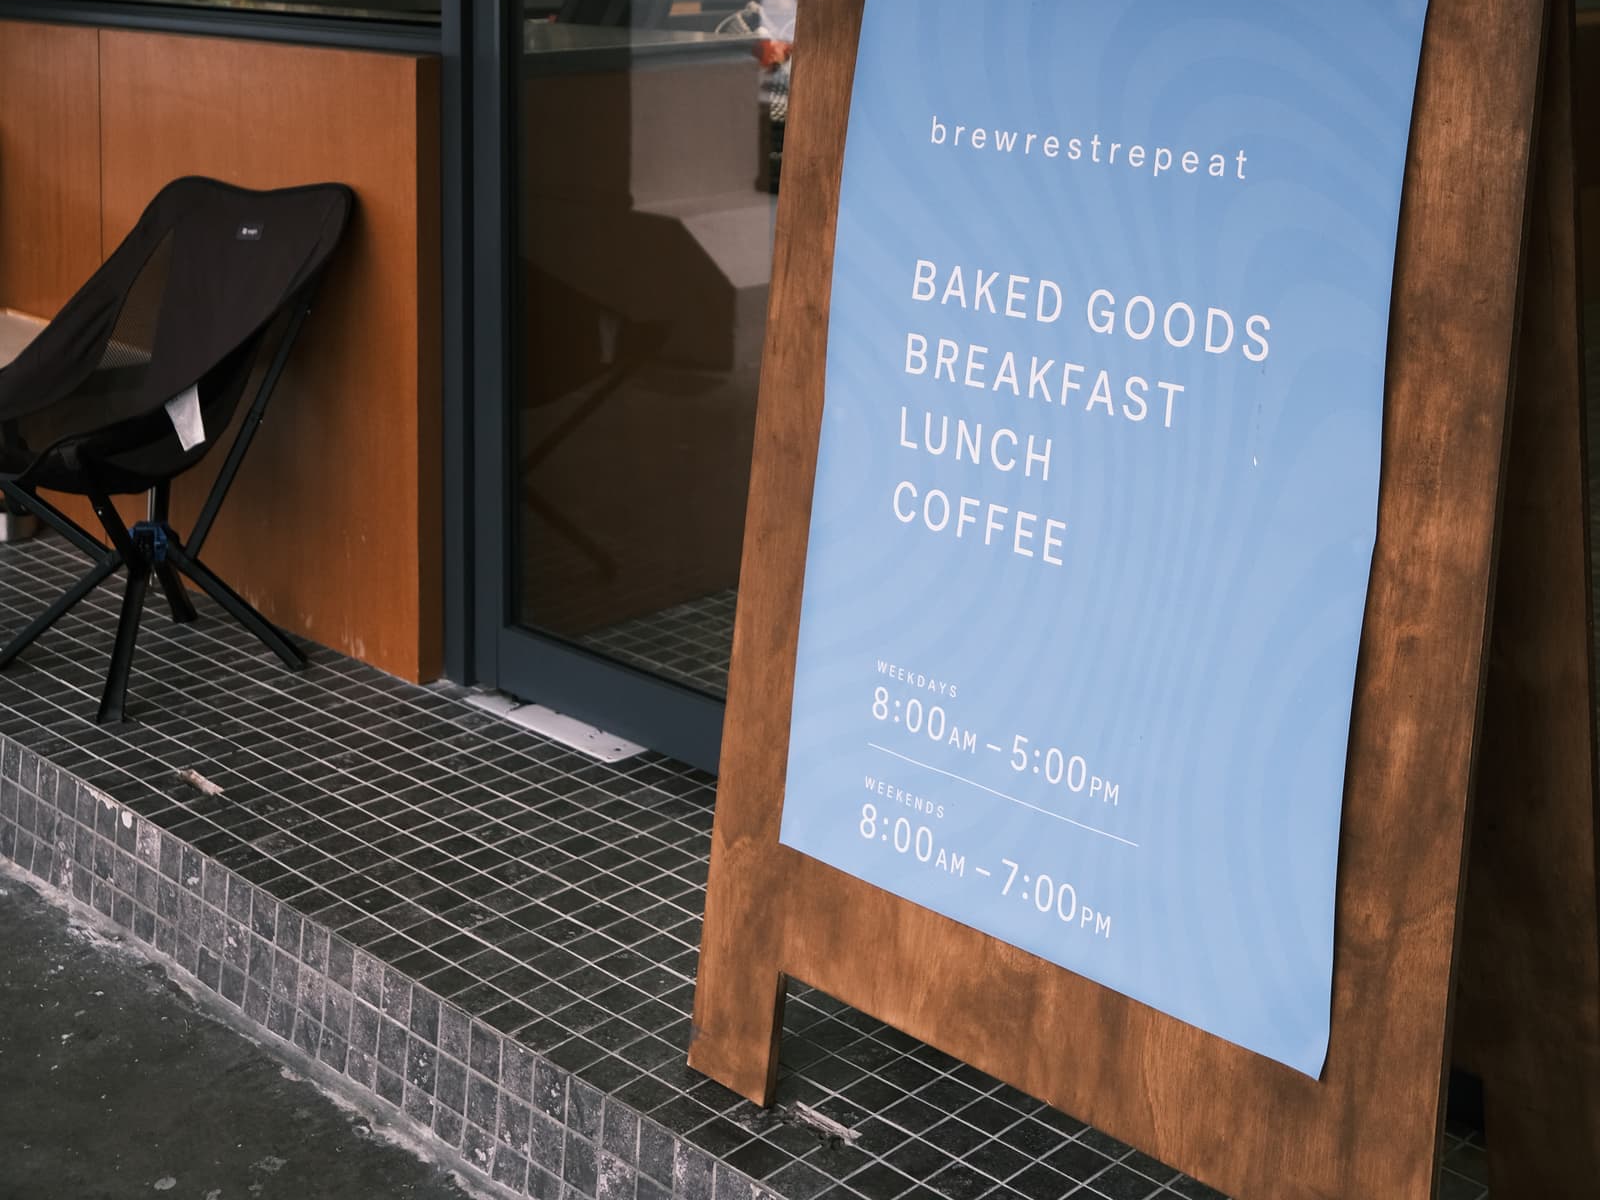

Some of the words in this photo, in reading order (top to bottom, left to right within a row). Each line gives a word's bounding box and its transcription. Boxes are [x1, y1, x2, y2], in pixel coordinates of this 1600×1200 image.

[930, 115, 1248, 180] brewrestrepeat
[911, 259, 1063, 324] BAKED
[1087, 288, 1271, 362] GOODS
[904, 332, 1185, 429] BREAKFAST
[899, 405, 1053, 481] LUNCH
[892, 480, 1067, 566] COFFEE
[876, 659, 958, 698] WEEKDAYS
[864, 775, 945, 819] WEEKENDS
